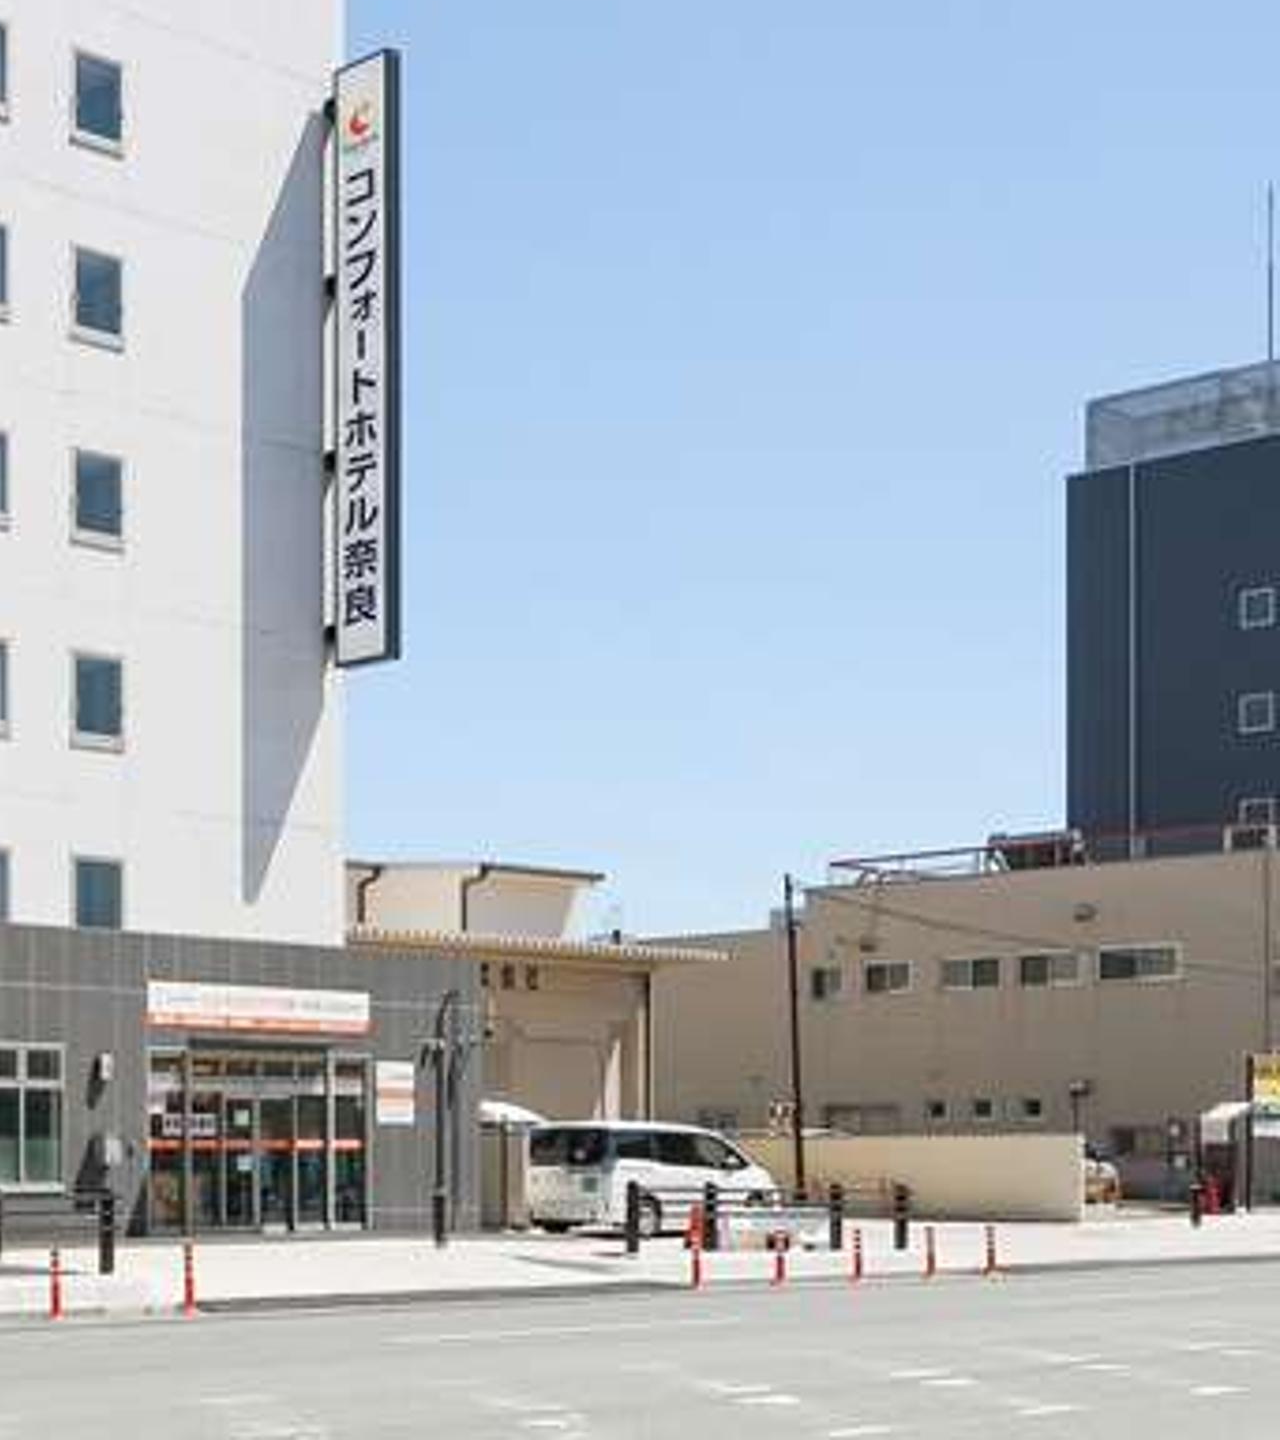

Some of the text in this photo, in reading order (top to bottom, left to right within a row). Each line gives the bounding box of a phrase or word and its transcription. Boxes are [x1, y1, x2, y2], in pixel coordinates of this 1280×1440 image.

[344, 168, 378, 627] コンフォートホテル奈良
